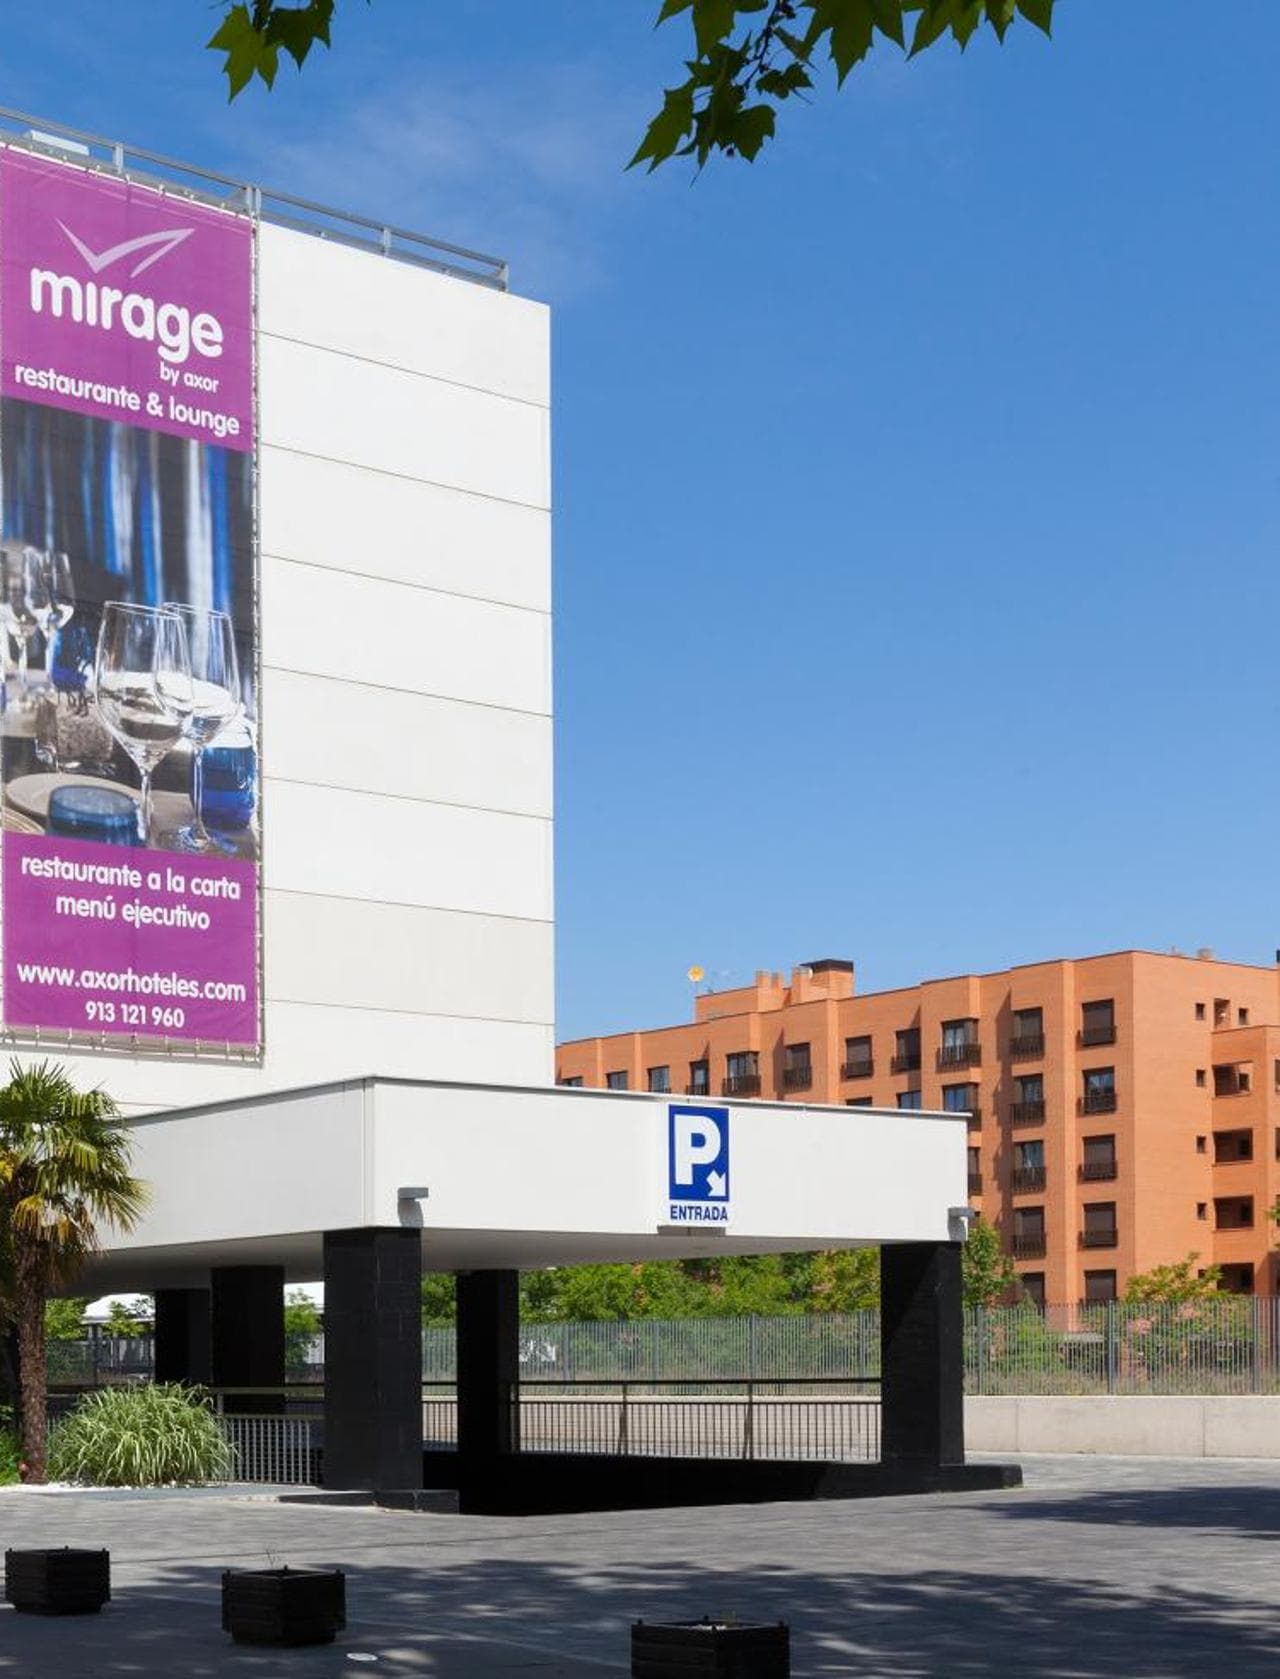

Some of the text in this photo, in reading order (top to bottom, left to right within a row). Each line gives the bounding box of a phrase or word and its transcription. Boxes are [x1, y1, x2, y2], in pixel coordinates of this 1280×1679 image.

[31, 267, 223, 363] mirage
[160, 361, 219, 393] by axor
[15, 365, 240, 437] restaurante & lounge
[21, 856, 241, 900] restaurante a la carta
[55, 895, 210, 929] menú ejecutivo
[17, 964, 246, 1002] www.axorhoteles.com
[85, 1001, 185, 1028] 913 121 960
[675, 1114, 721, 1185] P
[670, 1205, 728, 1221] ENTRADA
